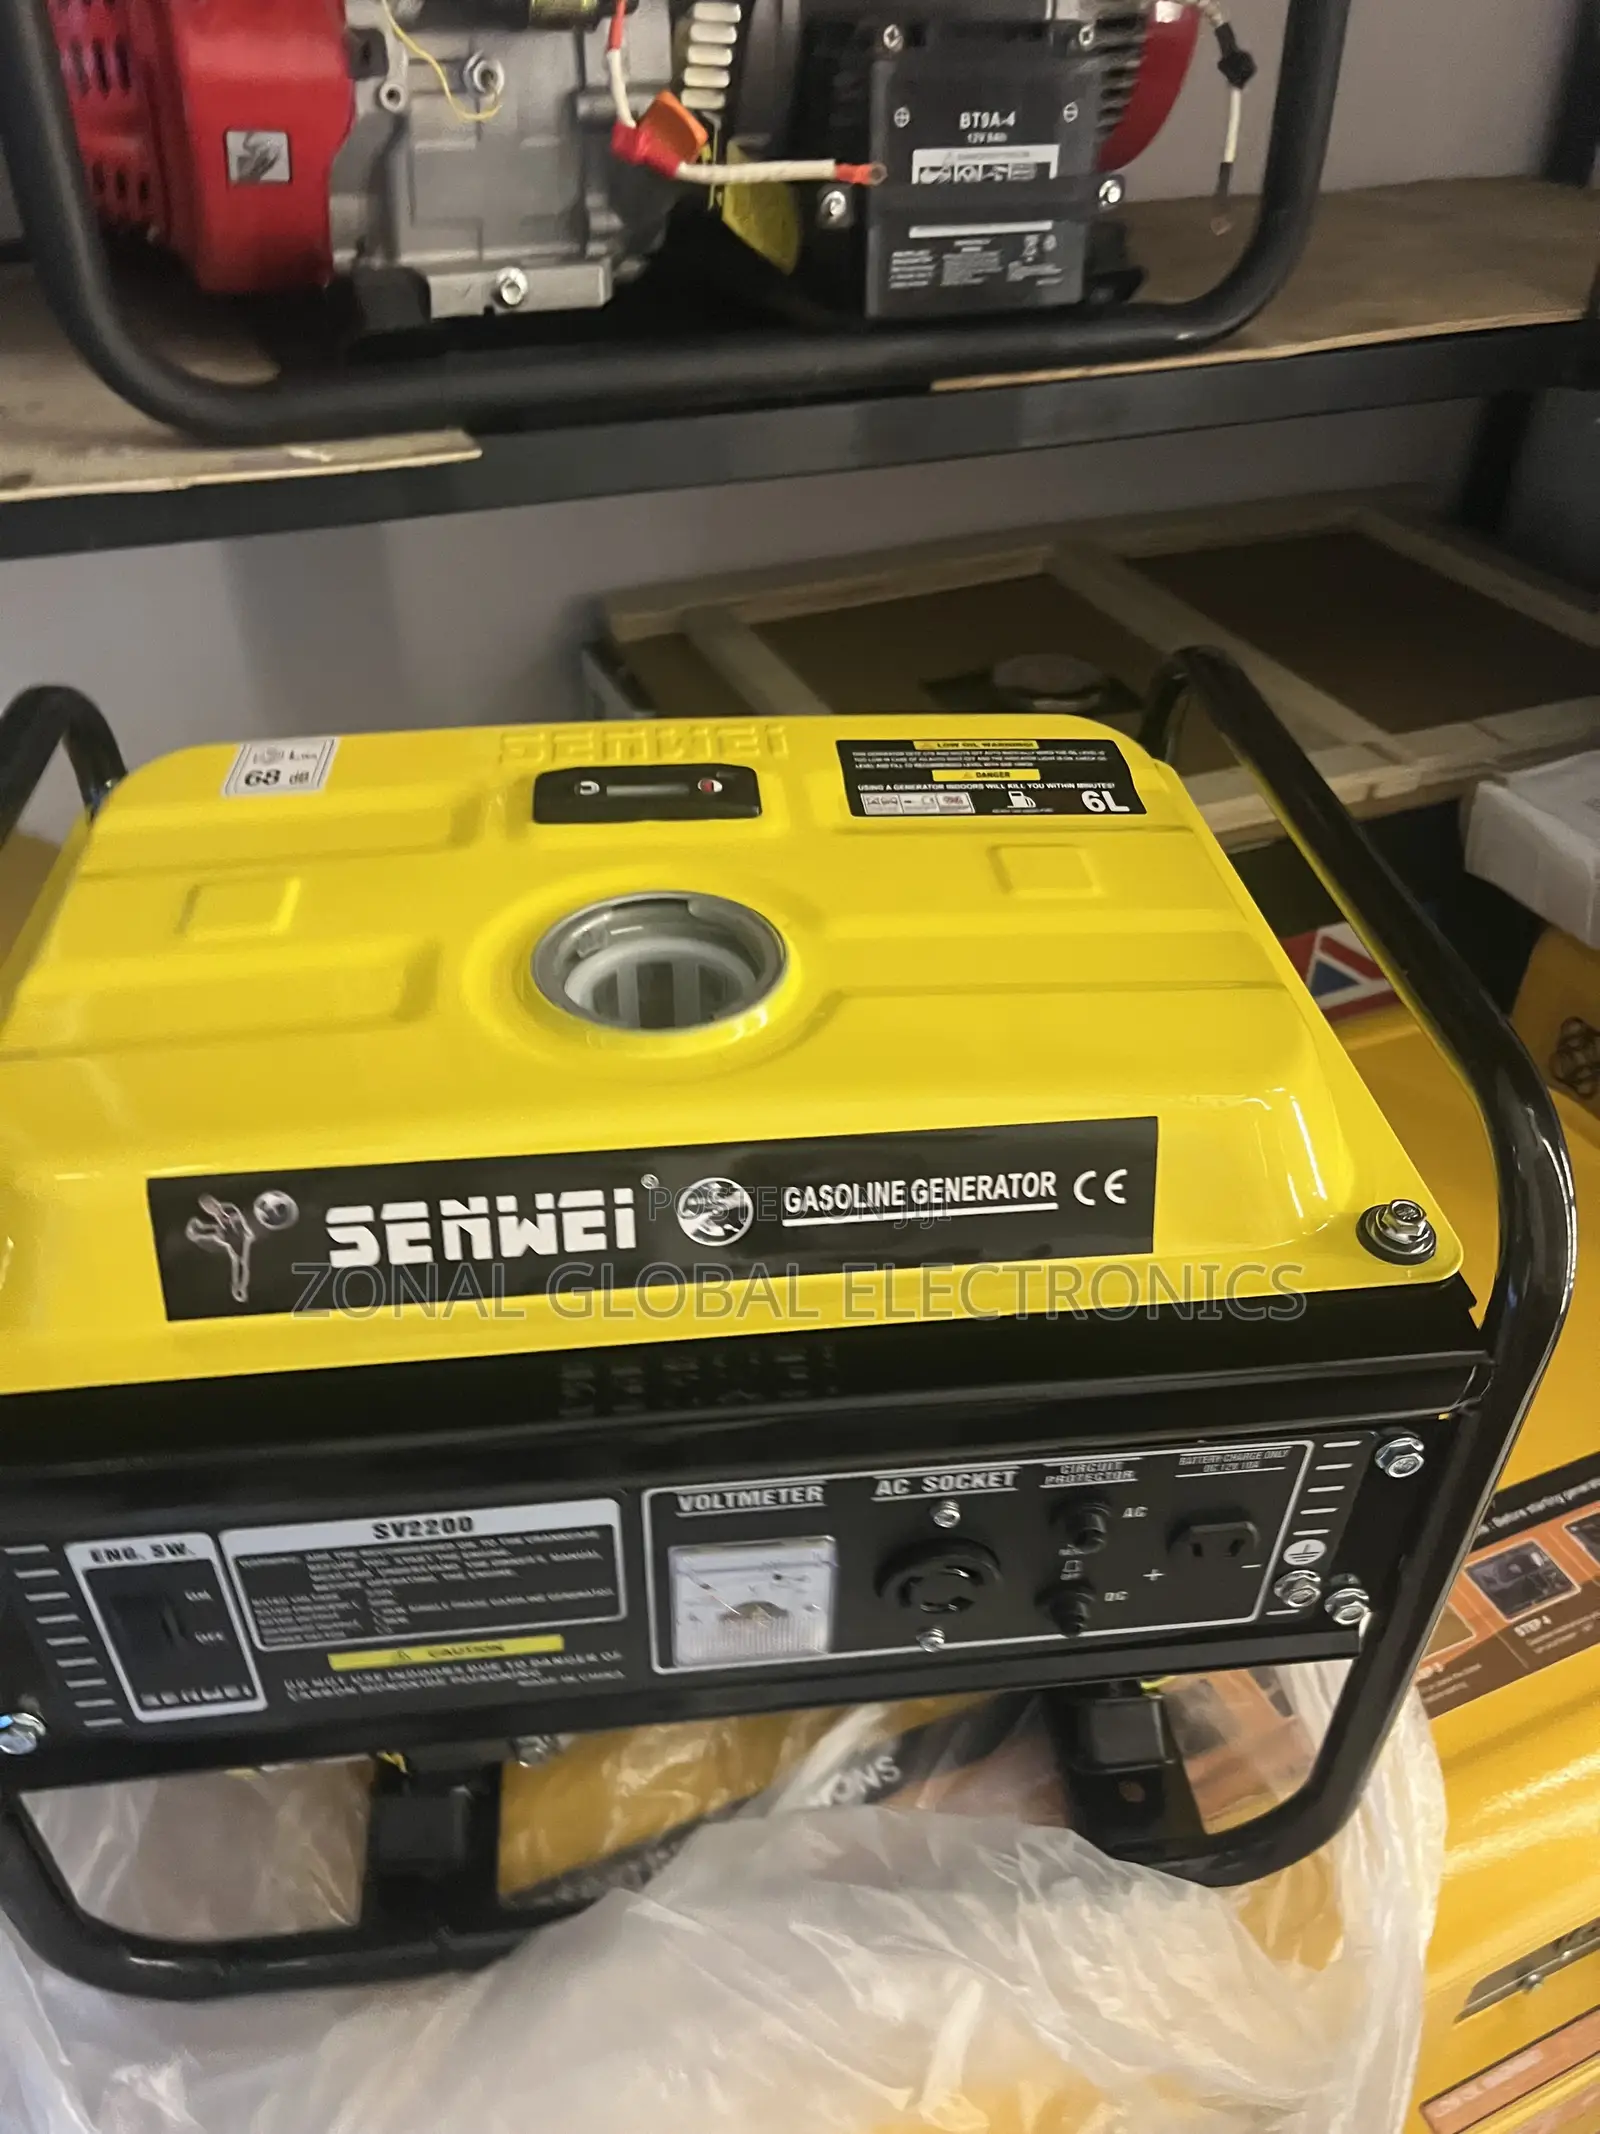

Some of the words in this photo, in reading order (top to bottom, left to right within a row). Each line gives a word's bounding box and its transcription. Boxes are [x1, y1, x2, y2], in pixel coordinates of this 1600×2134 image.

[244, 768, 281, 787] 68
[975, 771, 1011, 779] DANGER
[1081, 790, 1130, 812] 6L
[326, 1188, 637, 1268] SENWEI
[783, 1180, 906, 1213] GASOLINE
[910, 1171, 1057, 1205] GENERATOR
[1073, 1168, 1128, 1206] CE
[1179, 1455, 1222, 1466] BATTERY
[1222, 1451, 1262, 1463] CHARGE
[1262, 1449, 1290, 1460] ONLY
[1044, 1470, 1135, 1485] PROTECTOR
[1060, 1461, 1124, 1475] CIRCUIT
[874, 1478, 909, 1496] AC
[921, 1470, 1017, 1494] SOCKET
[677, 1485, 825, 1512] VOLTMETER
[1122, 1506, 1148, 1518] AC
[371, 1515, 474, 1539] SV2200
